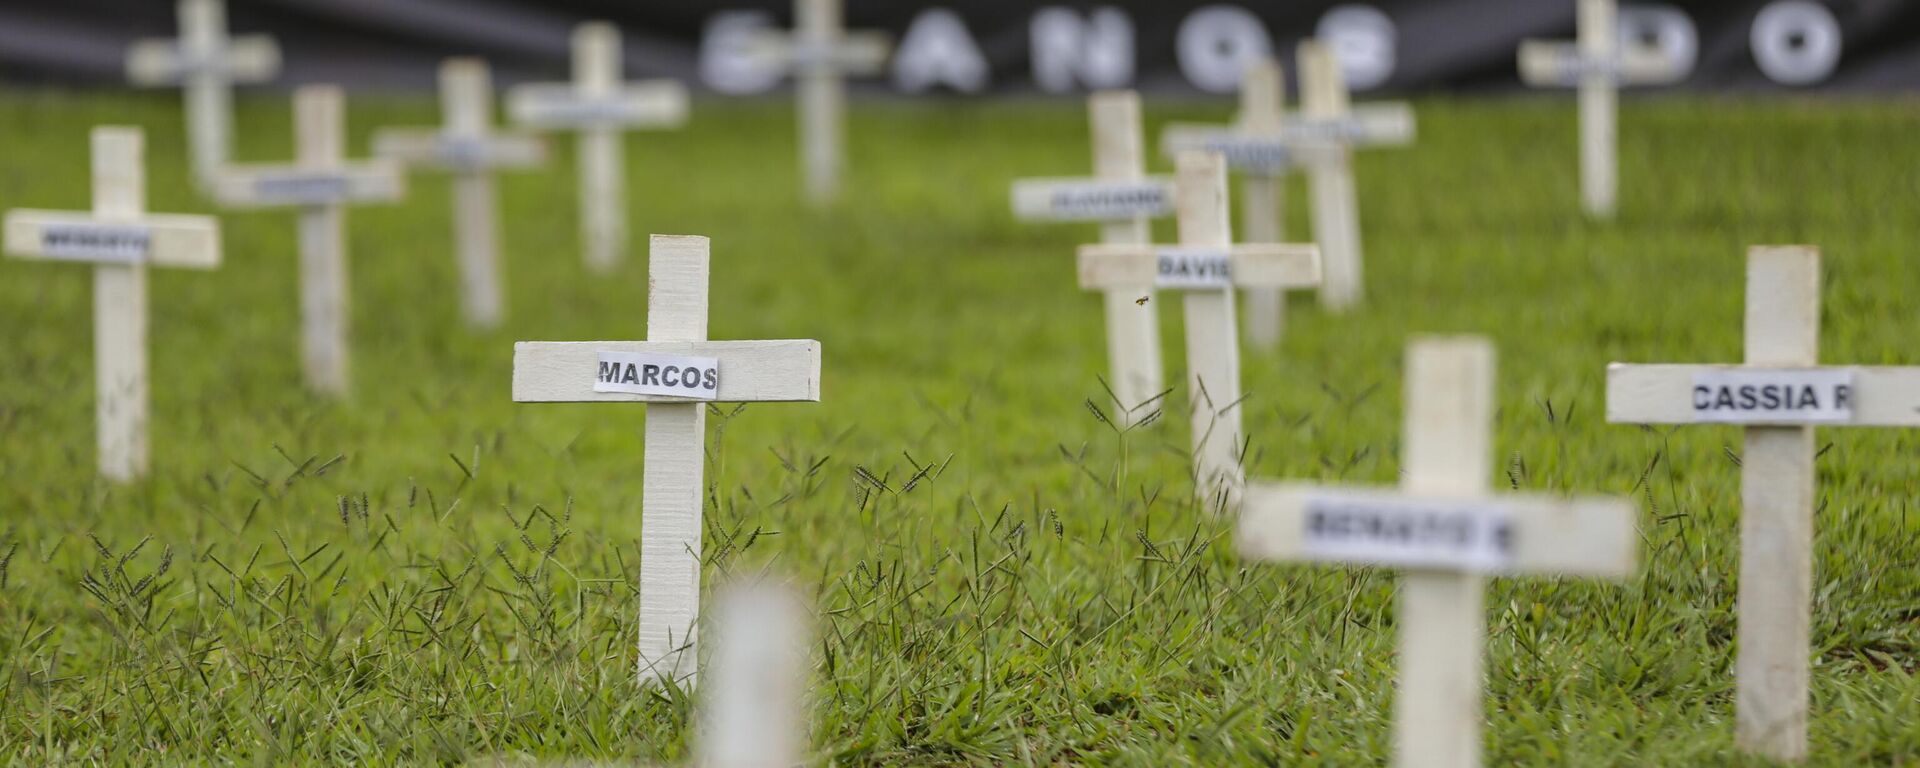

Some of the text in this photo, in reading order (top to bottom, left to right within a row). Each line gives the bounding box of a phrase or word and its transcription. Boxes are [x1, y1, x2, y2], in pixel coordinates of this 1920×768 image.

[892, 3, 1398, 95] ANOS
[598, 361, 717, 391] MARCOS
[1693, 384, 1819, 410] CASSIA
